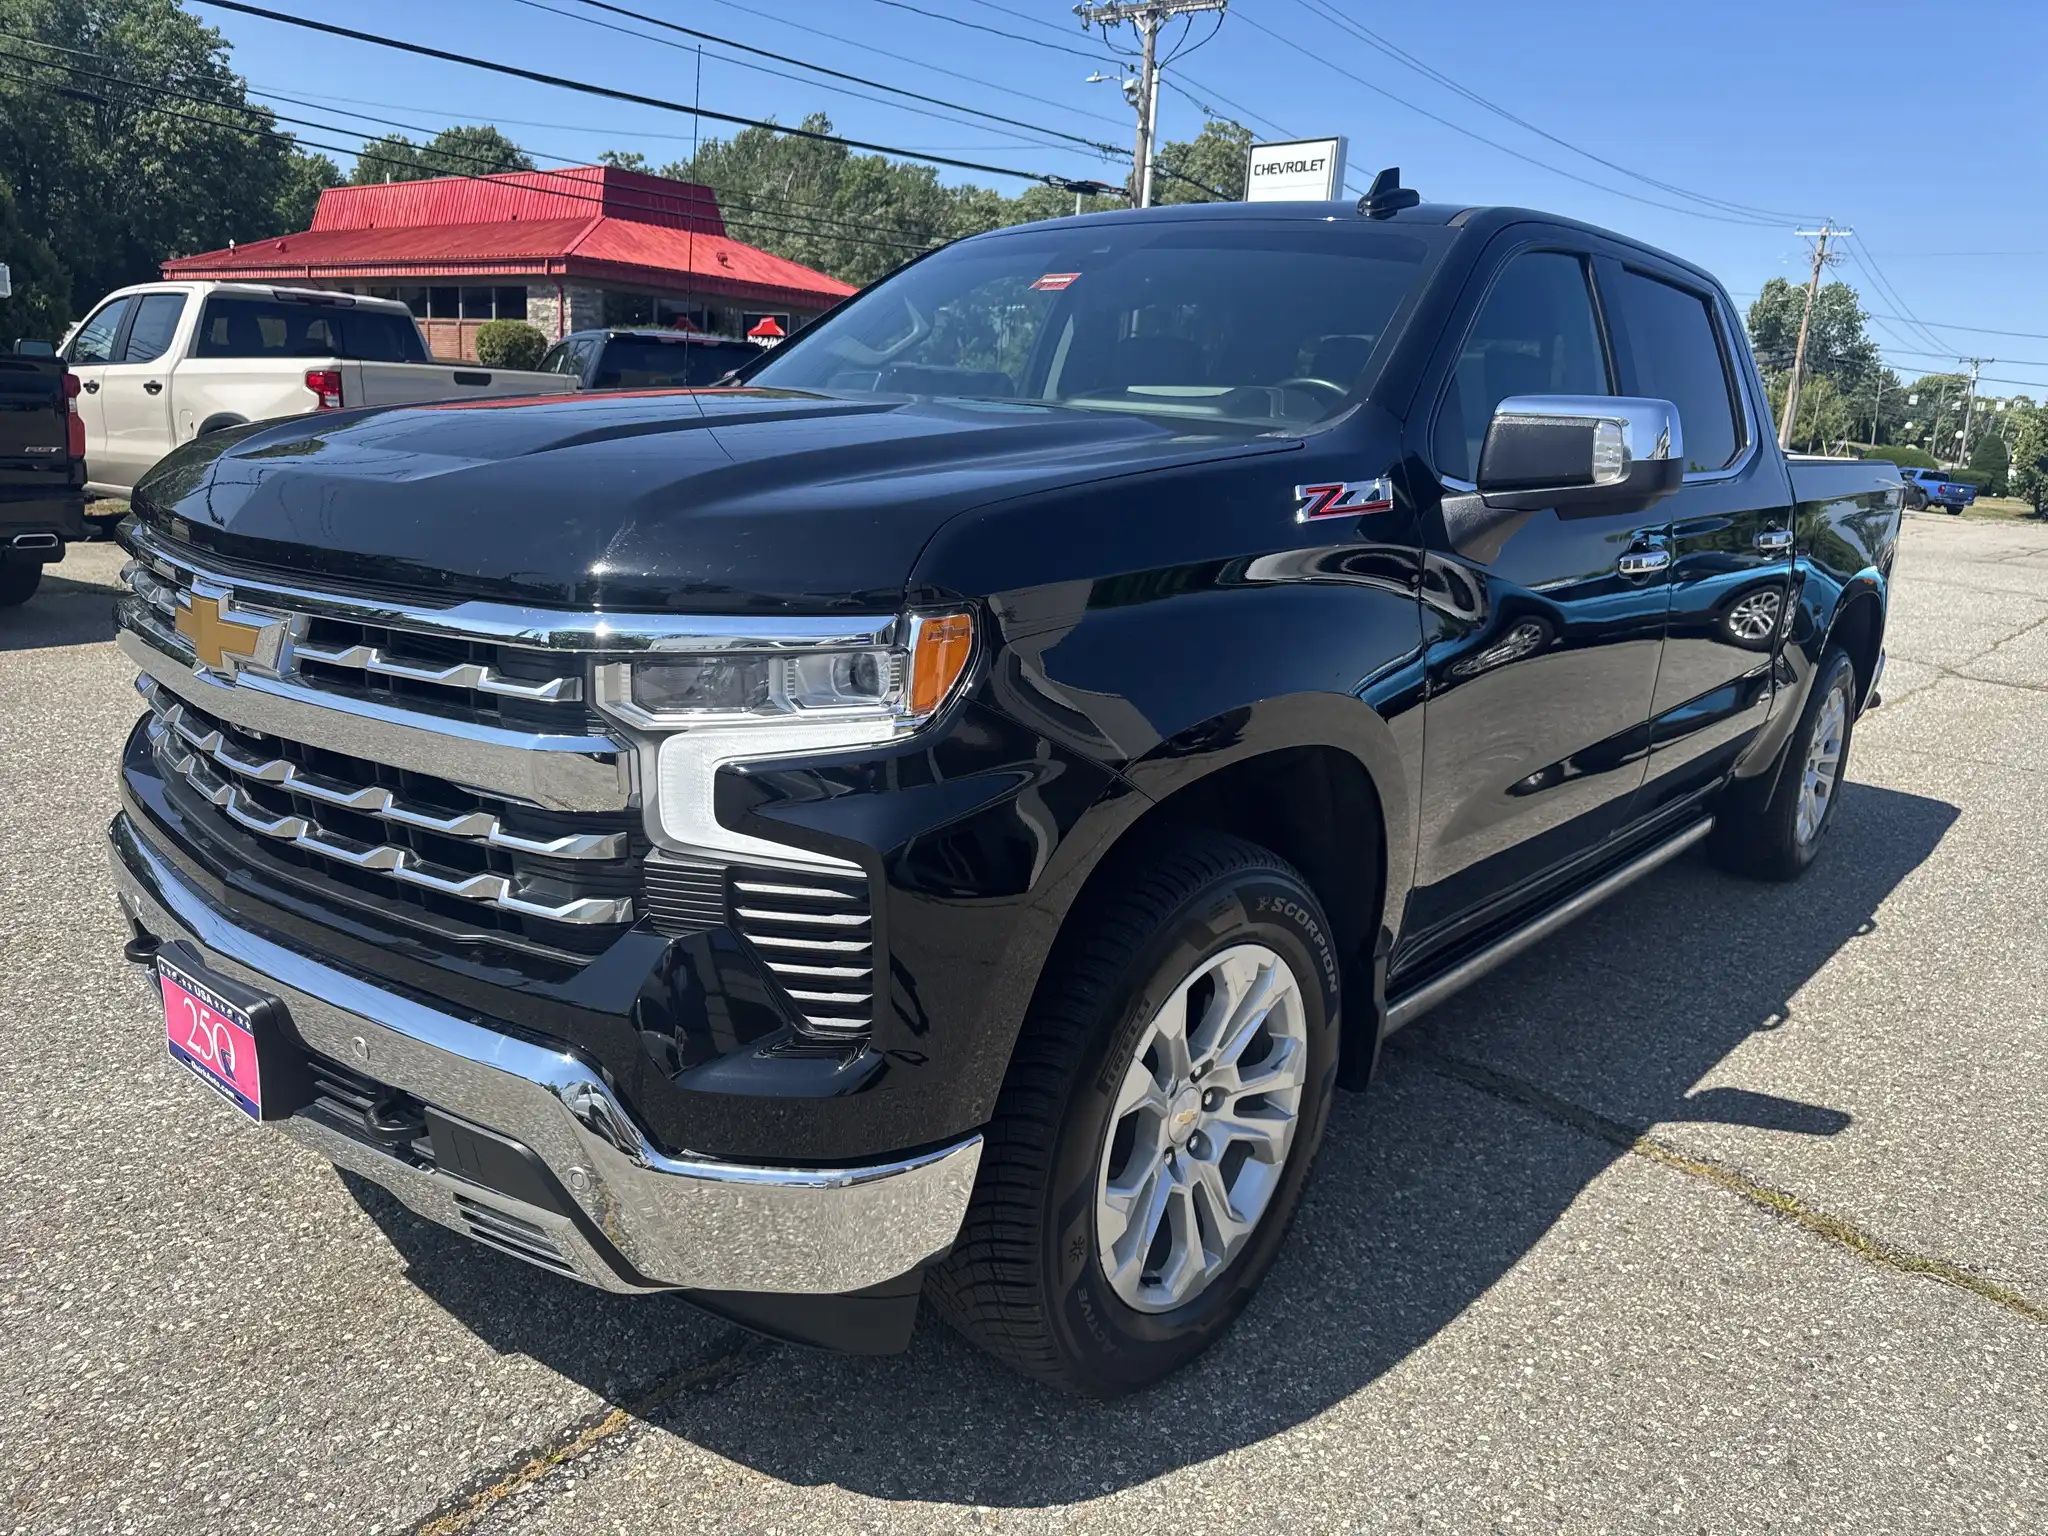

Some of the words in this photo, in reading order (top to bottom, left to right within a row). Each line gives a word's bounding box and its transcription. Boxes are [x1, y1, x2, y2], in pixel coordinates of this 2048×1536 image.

[1254, 159, 1326, 176] CHEVROLET
[1295, 478, 1393, 524] Z71
[1270, 896, 1338, 993] SCORPION
[194, 985, 213, 1006] USA
[183, 997, 236, 1076] 250
